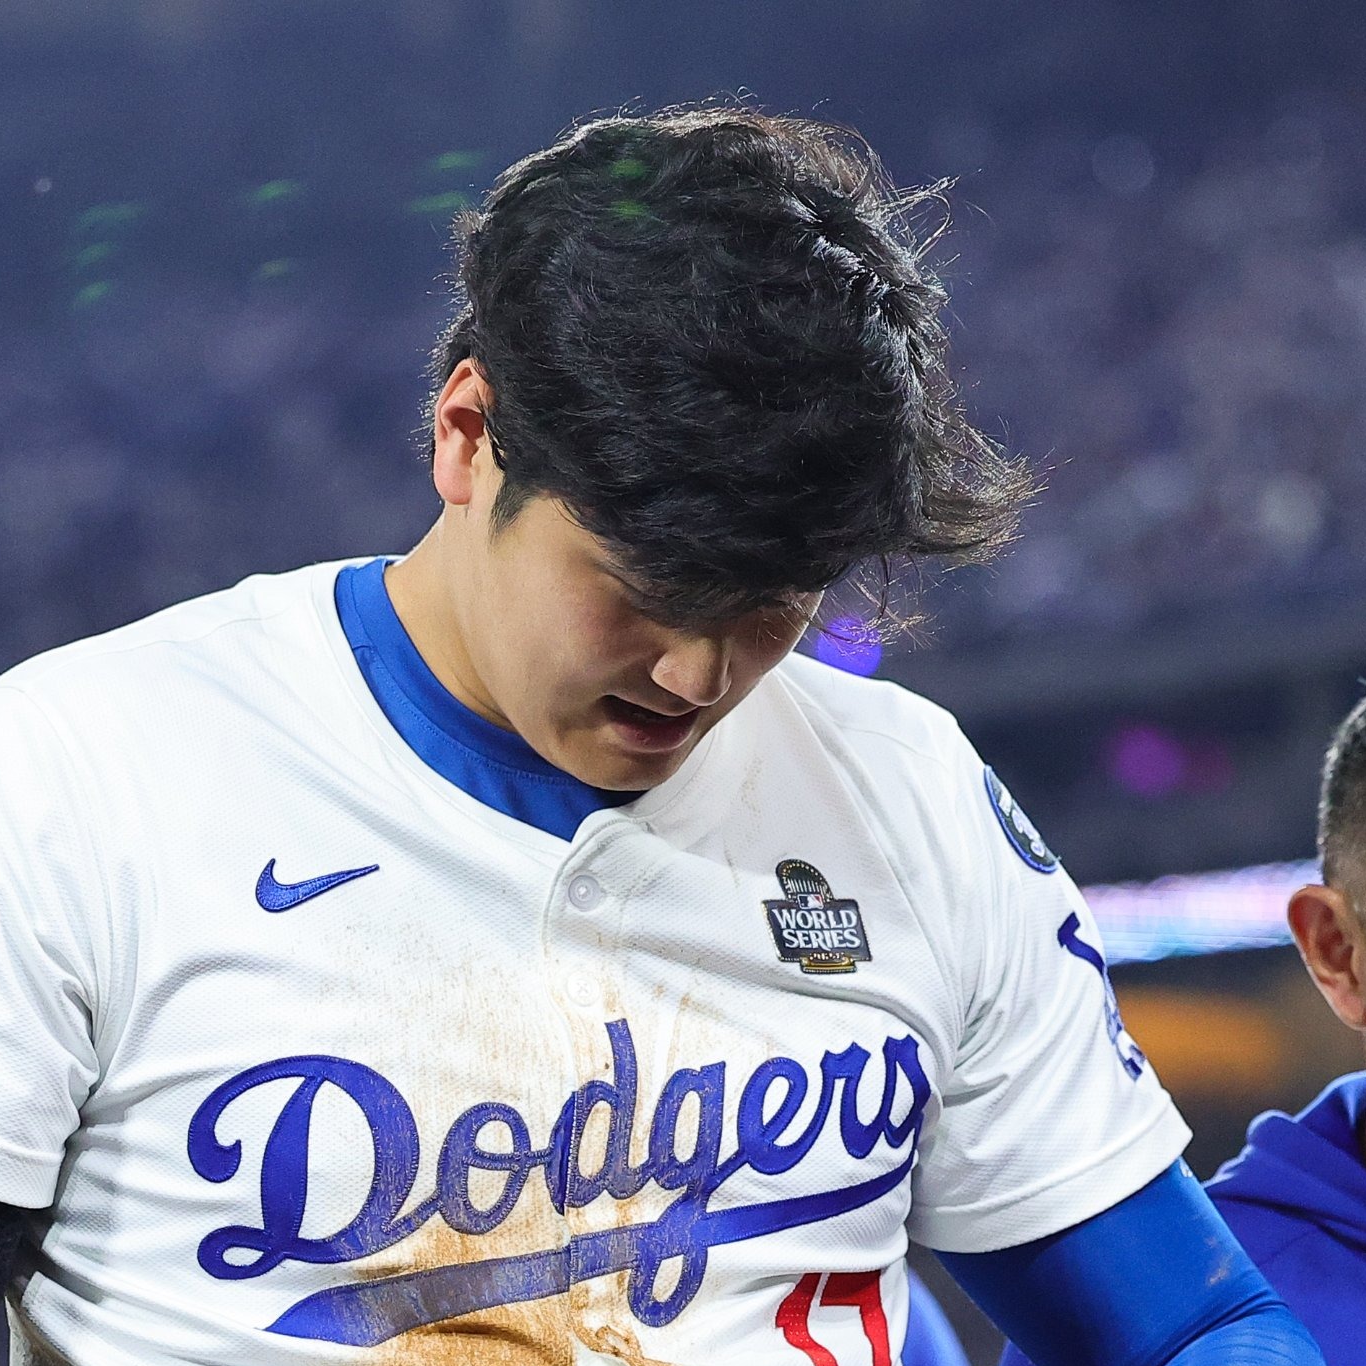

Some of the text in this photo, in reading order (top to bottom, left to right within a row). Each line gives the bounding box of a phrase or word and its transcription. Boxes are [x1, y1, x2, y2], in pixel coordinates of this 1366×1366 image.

[772, 908, 857, 929] WORLD
[782, 928, 861, 951] SERIES
[188, 1018, 931, 1327] Dodgers
